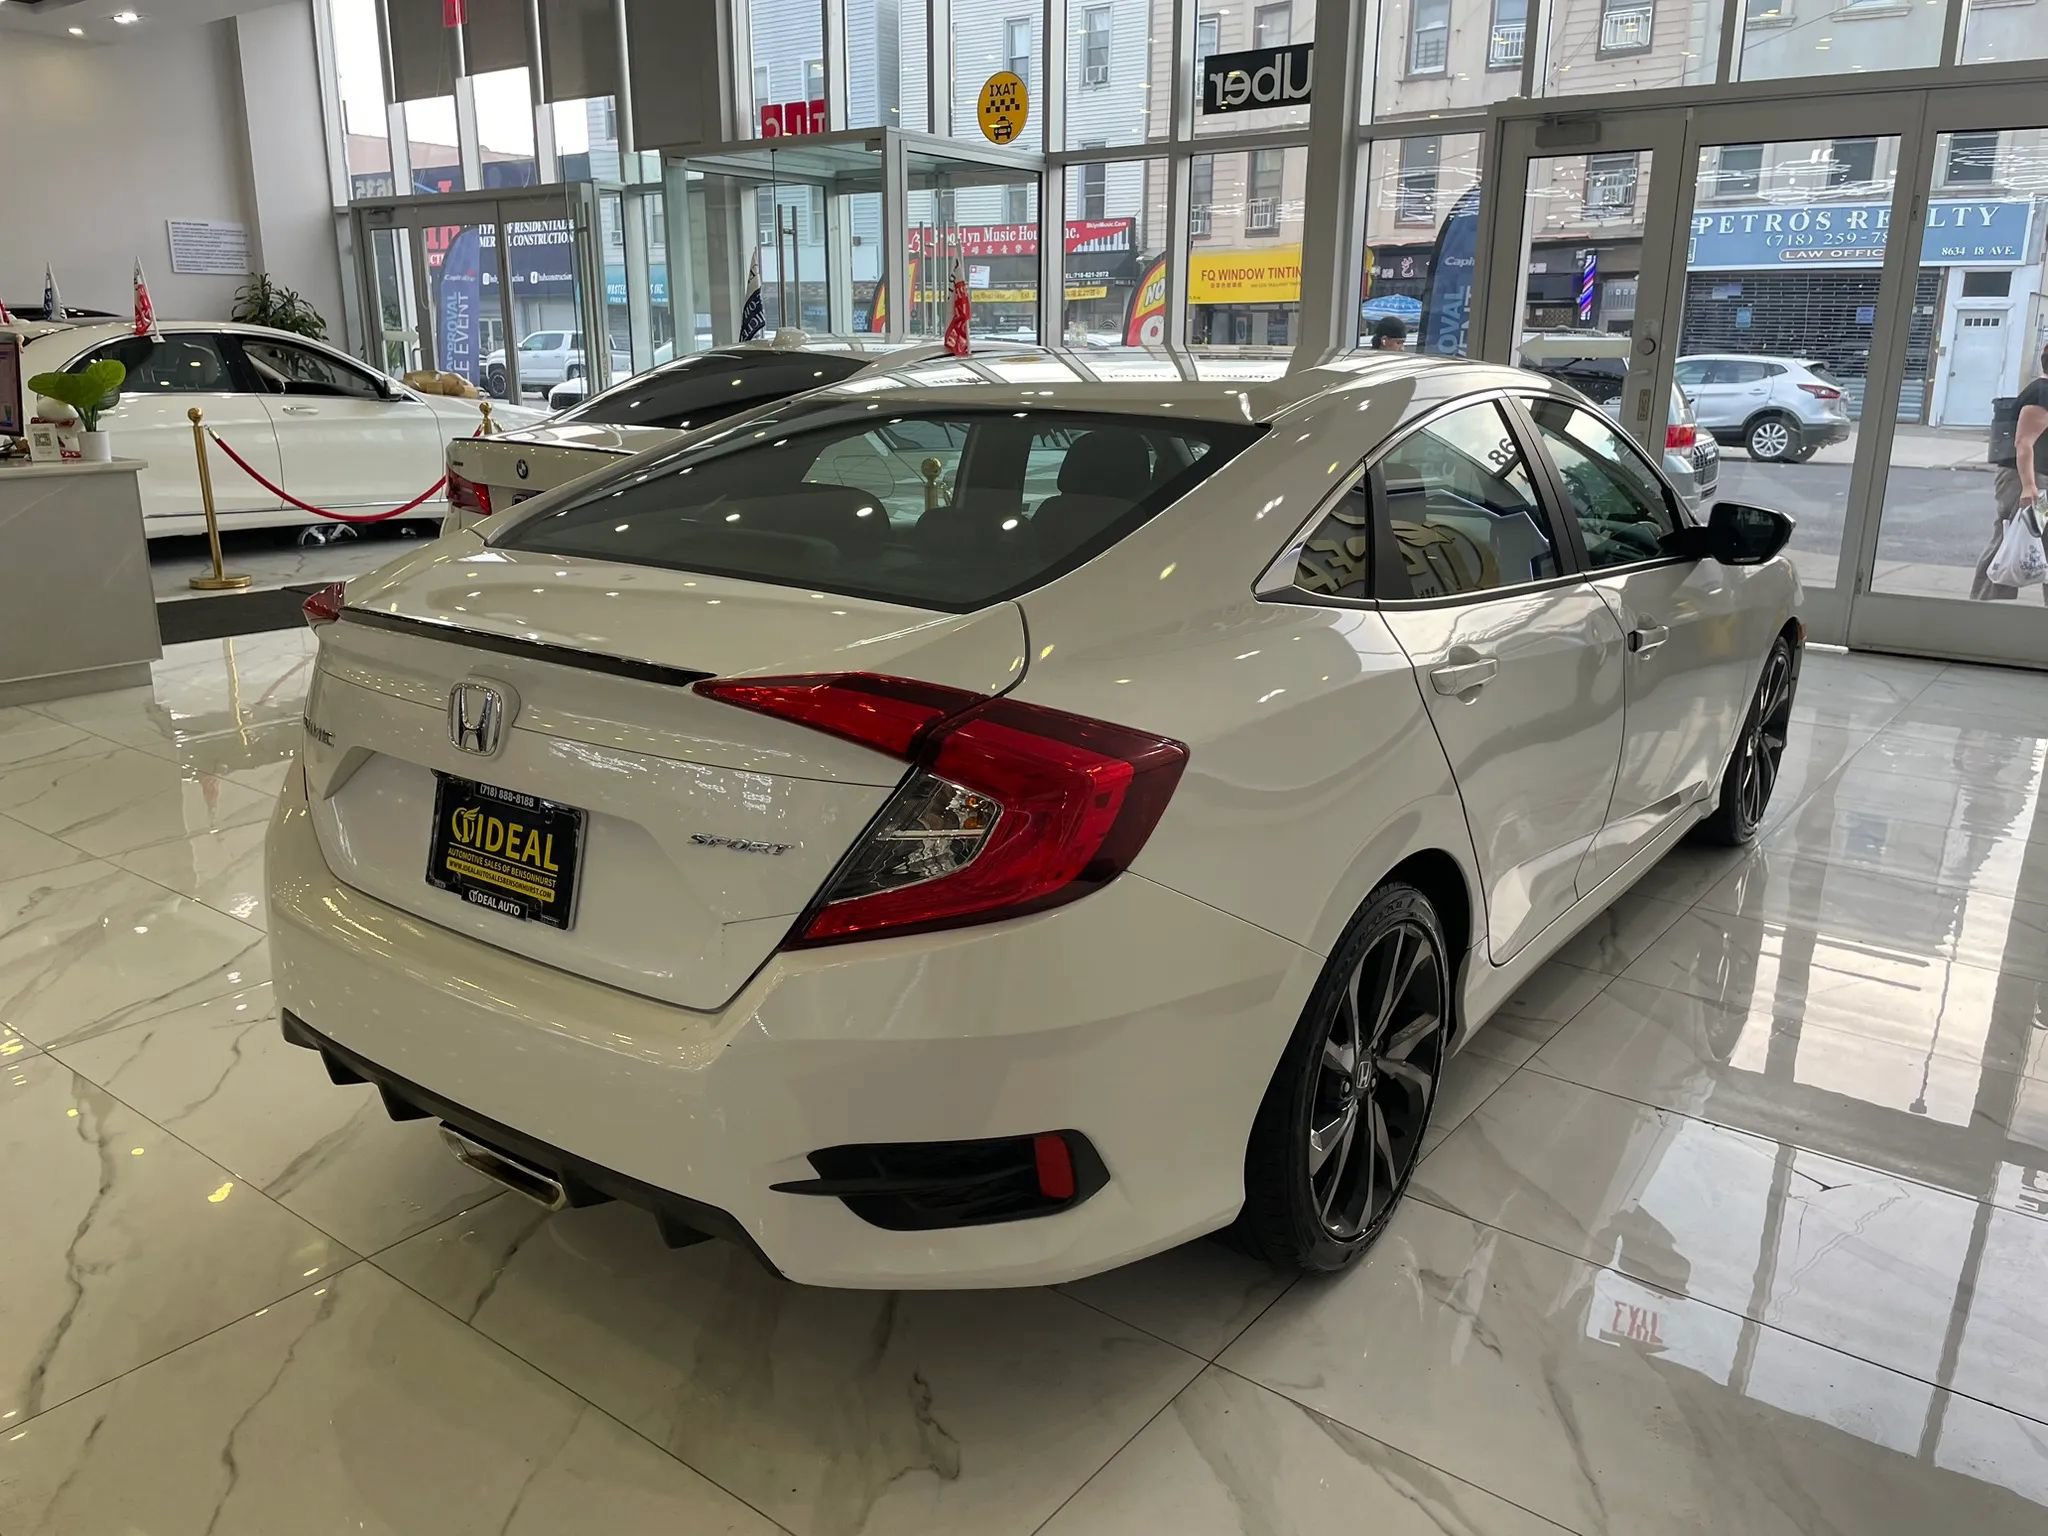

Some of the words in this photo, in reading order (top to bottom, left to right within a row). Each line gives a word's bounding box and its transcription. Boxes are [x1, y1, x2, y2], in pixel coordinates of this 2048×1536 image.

[1848, 205, 2000, 230] RELTY
[515, 219, 568, 234] RESIDENTIAL
[983, 226, 1012, 243] Music
[1065, 227, 1080, 239] nc.
[513, 230, 575, 247] CONSTRUCTION
[1766, 233, 1813, 246] (718)
[1824, 231, 1888, 246] 259-78
[1786, 250, 1823, 259] LAW
[1831, 248, 1885, 258] OFFIC
[1941, 246, 1966, 256] 8634
[1974, 246, 1985, 256] 18
[1201, 269, 1216, 281] FQ
[1218, 267, 1265, 281] WINDOW
[1268, 266, 1302, 279] TINTIN
[1144, 277, 1166, 307] NO
[454, 292, 469, 354] EVENT
[1438, 285, 1466, 355] OVAL
[446, 292, 457, 371] APPROVAL
[480, 783, 498, 798] (718)
[474, 812, 559, 872] IDEAL
[689, 832, 796, 856] SPORT
[447, 847, 483, 867] AUTOMOTIVE
[484, 858, 502, 872] SALES
[502, 863, 510, 873] OF
[511, 866, 557, 889] BENSONHURST
[497, 900, 521, 916] AUTO
